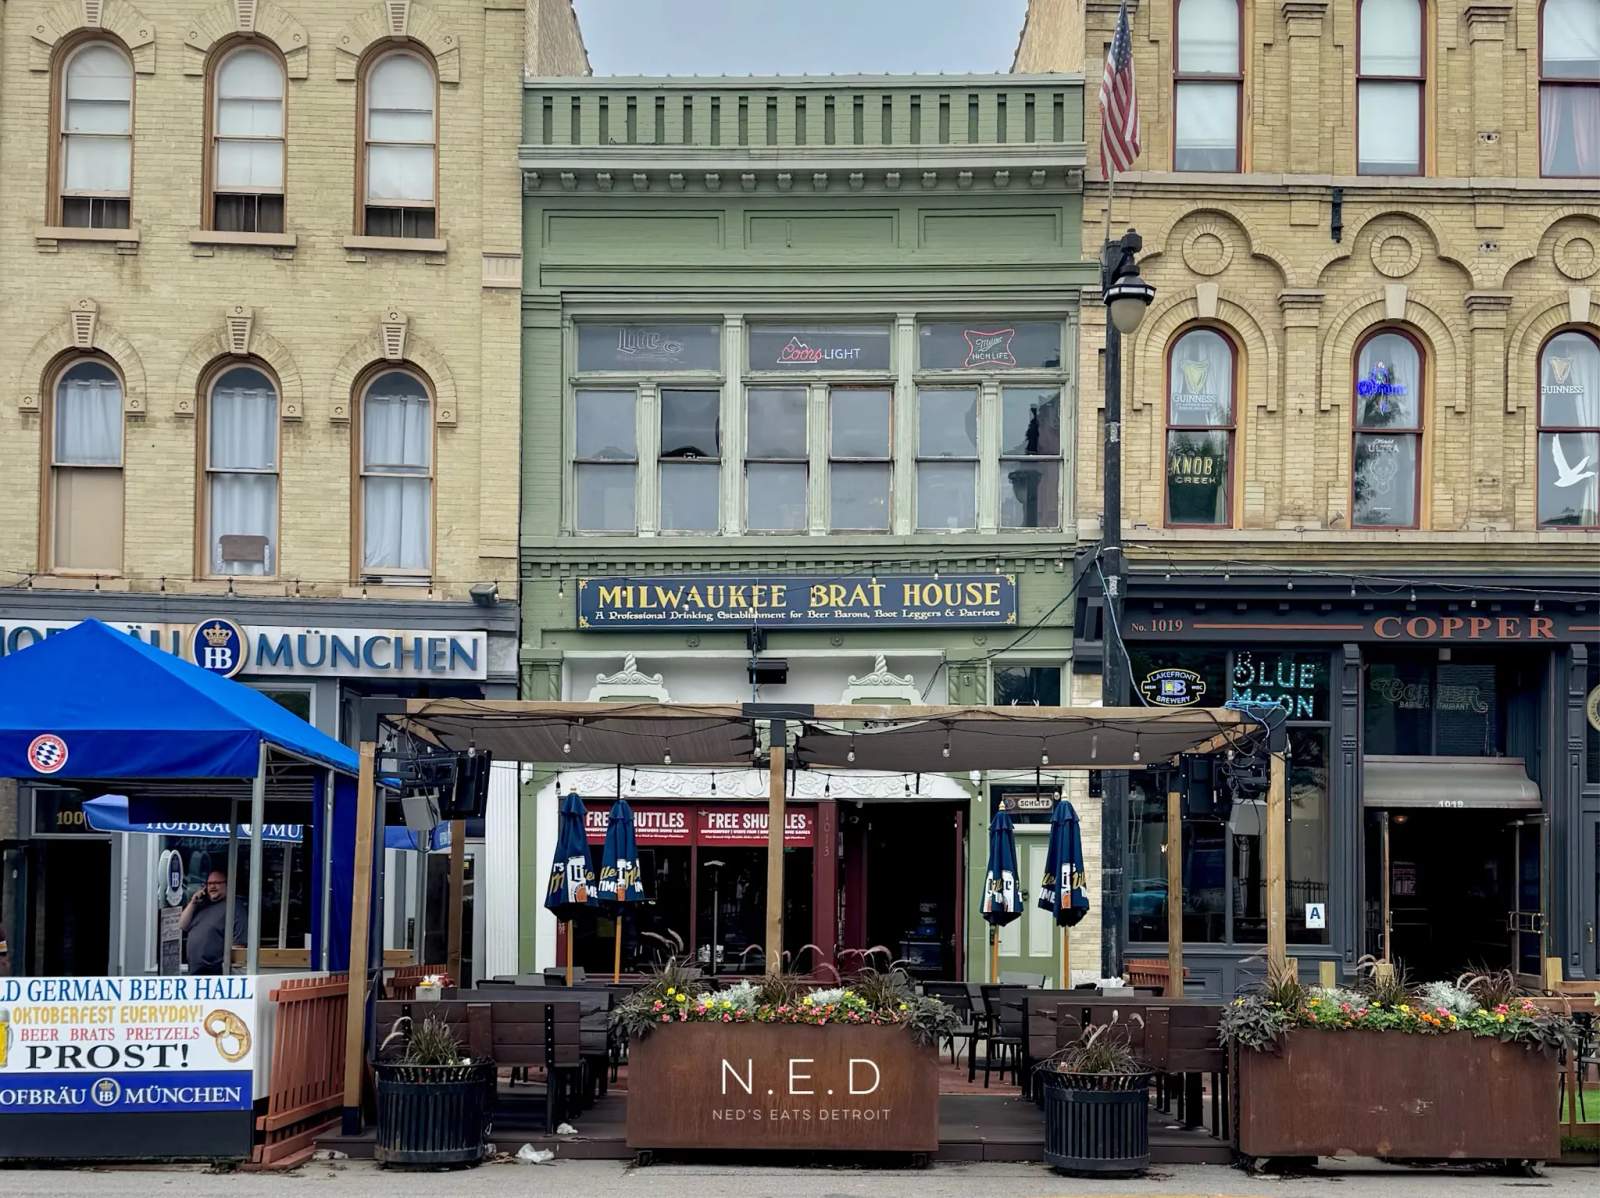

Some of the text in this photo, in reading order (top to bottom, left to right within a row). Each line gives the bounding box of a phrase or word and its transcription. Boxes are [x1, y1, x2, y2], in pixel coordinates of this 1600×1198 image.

[824, 348, 861, 360] LIGHT
[1173, 394, 1217, 403] GUINNESS
[1172, 456, 1213, 475] KNOB
[1175, 477, 1216, 485] CREEK
[598, 582, 1000, 609] MILWAUKEE BRAT HOUSE
[595, 608, 1000, 622] A Professional Drinking Establishment for Beer Barons, Boot Leggers & Patriots
[1131, 619, 1184, 632] No. 1019
[1373, 615, 1558, 640] COPPER
[203, 647, 233, 669] HB
[255, 628, 479, 672] MÜNCHEN
[1150, 671, 1197, 682] LAKEFRONT
[1155, 695, 1191, 704] BREWERY
[586, 811, 685, 827] FRE UTTLES
[708, 813, 806, 829] FREE SHULES
[1310, 906, 1321, 919] A
[27, 978, 122, 1002] GERMAN
[130, 978, 188, 1001] BEER
[194, 977, 254, 1000] HALL
[13, 1004, 204, 1025] OKTOBERFEST EVERYDAY!
[20, 1026, 200, 1042] BEER BRATS PRETZELS
[25, 1043, 189, 1070] PROST!
[99, 1091, 114, 1102] HB
[124, 1085, 242, 1105] MÜNCHEN
